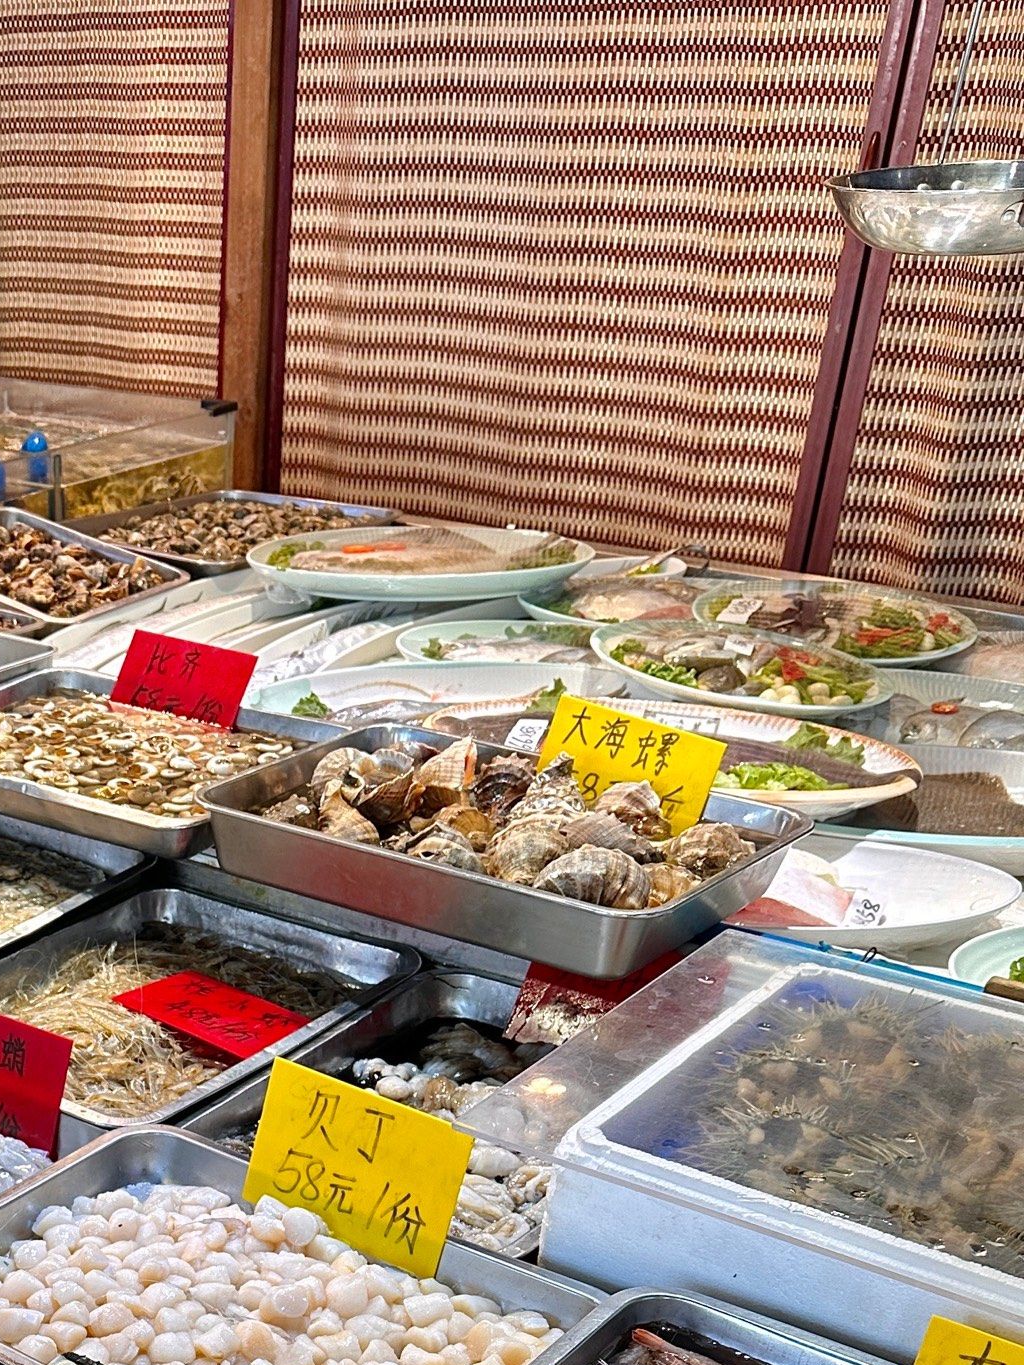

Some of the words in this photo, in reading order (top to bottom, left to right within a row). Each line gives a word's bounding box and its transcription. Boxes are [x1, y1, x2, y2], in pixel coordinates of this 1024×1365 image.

[562, 706, 680, 776] 大海螺
[301, 1090, 395, 1164] 贝丁
[273, 1148, 426, 1255] 58元/份
